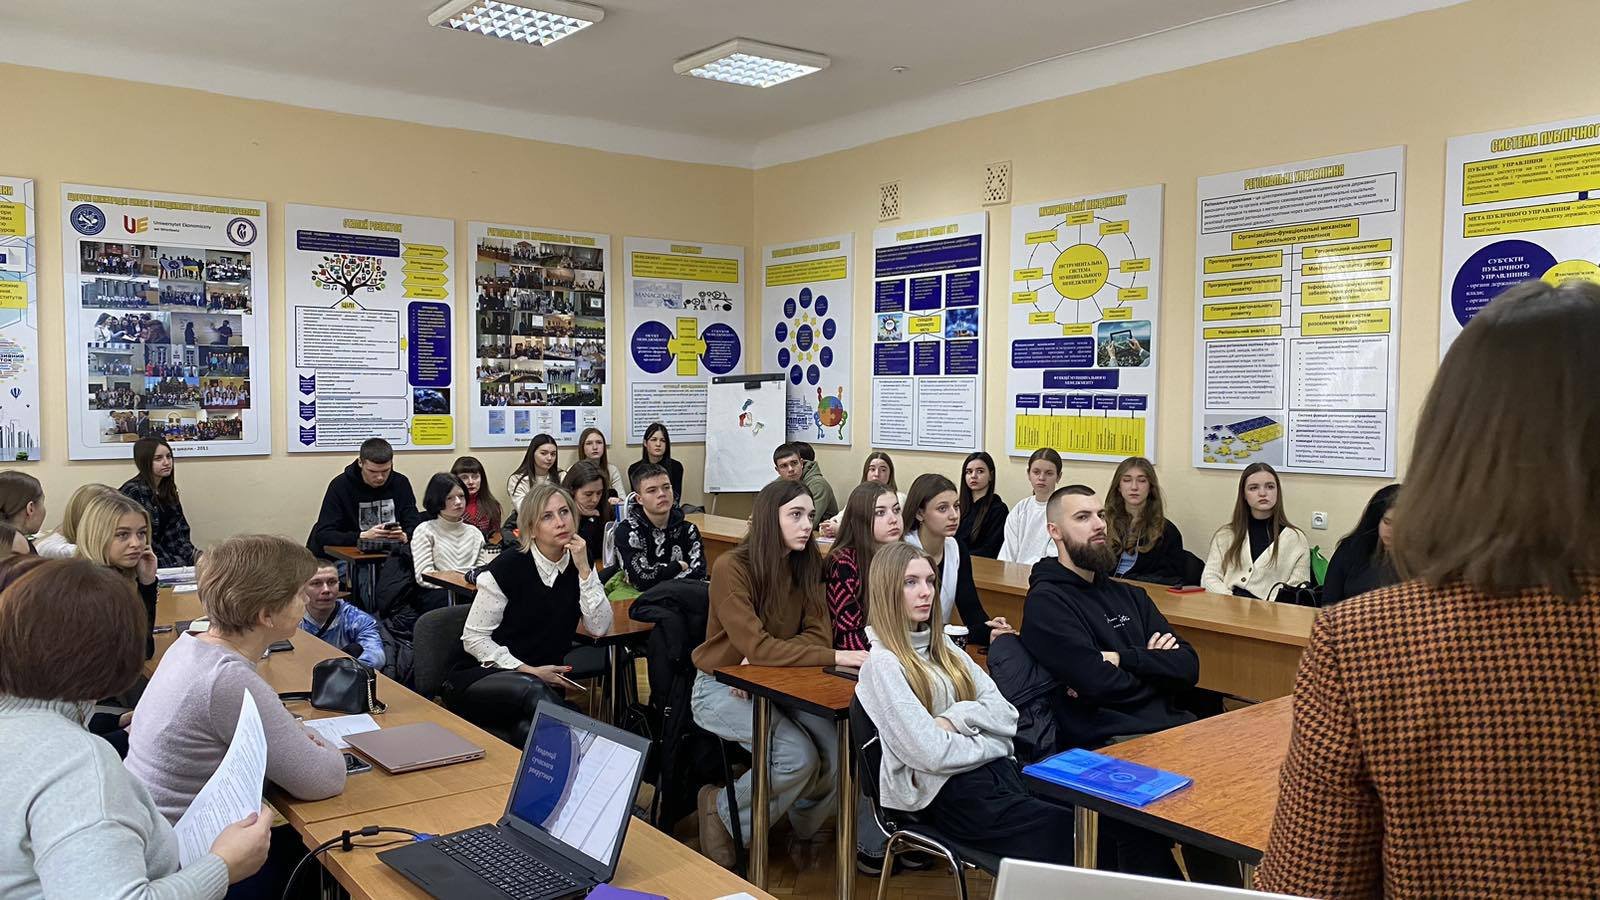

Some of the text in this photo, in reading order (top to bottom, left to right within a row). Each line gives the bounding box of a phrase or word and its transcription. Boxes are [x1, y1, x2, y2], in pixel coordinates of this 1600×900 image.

[1491, 123, 1600, 153] СИСТЕМА ПУБЛІЧНОГ
[1502, 158, 1543, 167] УПРАВЛІННЯ
[1295, 164, 1344, 182] УПРАВЛІННЯ
[1486, 211, 1526, 219] ПУБЛІЧНОГО
[1528, 206, 1570, 214] УПРАВЛІННЯ
[122, 214, 149, 235] UE
[1482, 264, 1529, 272] ПУБЛІЧНОГО
